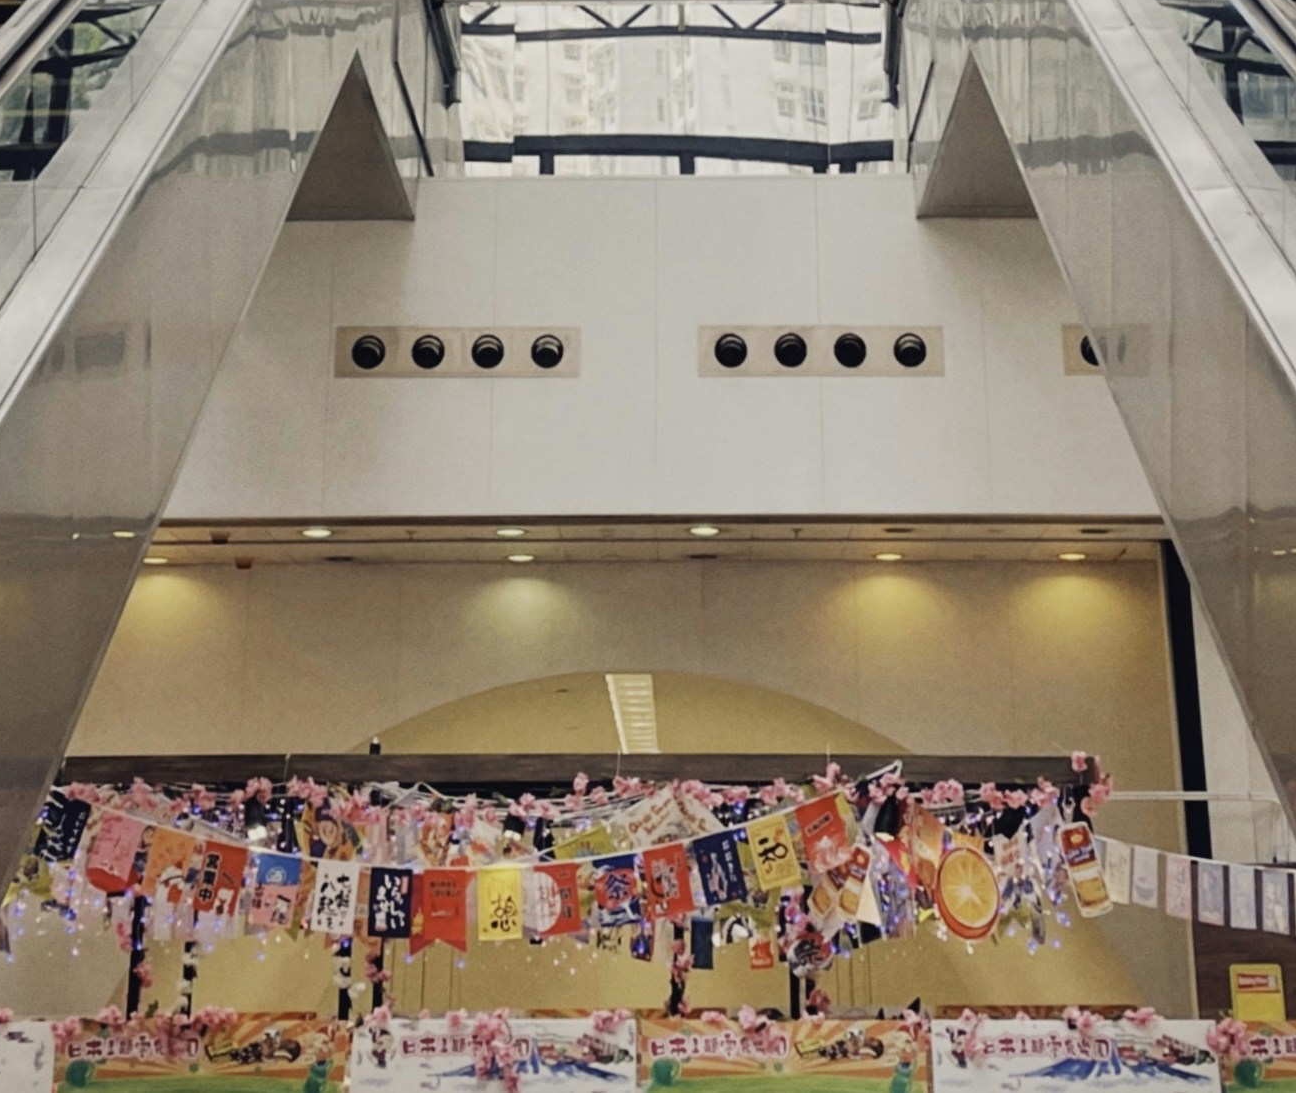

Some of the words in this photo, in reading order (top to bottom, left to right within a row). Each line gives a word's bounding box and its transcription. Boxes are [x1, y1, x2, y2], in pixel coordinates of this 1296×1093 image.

[198, 853, 221, 901] 営業中
[605, 873, 631, 901] 祭
